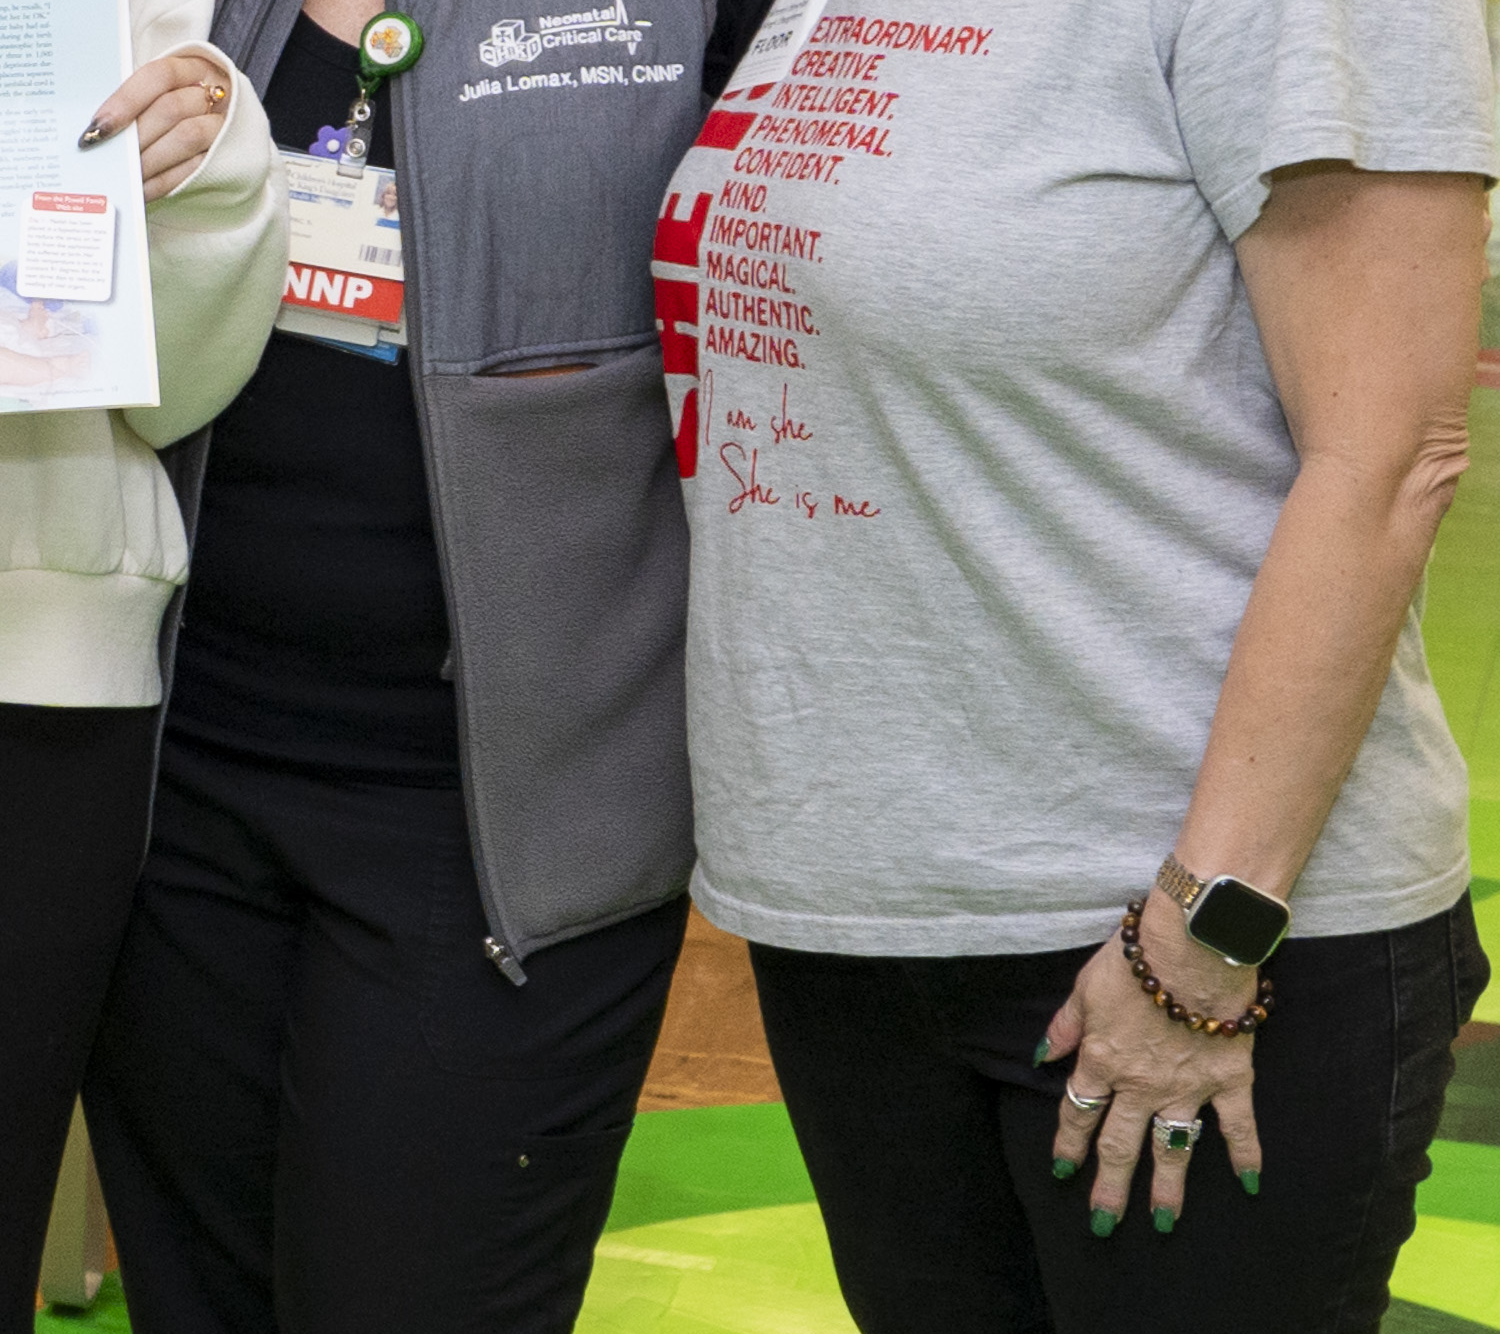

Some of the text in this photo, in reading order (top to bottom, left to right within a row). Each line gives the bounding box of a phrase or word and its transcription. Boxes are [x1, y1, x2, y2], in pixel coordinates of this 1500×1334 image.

[539, 5, 616, 29] Neonatal
[809, 16, 994, 56] EXTRAORDINARY.
[542, 27, 643, 48] Critical Care
[459, 63, 685, 102] Julia Lomax, MSN, CNNP
[790, 50, 886, 82] CREATIVE.
[771, 83, 900, 121] INTELLIGENT.
[751, 114, 894, 158] PHENOMENAL.
[733, 148, 844, 185] CONFIDENT.
[719, 179, 768, 214] KIND.
[708, 214, 823, 263] IMPORTANT.
[706, 251, 796, 295] MAGICAL.
[705, 287, 821, 336] AUTHENTIC.
[704, 325, 807, 370] AMAZING.
[727, 409, 758, 431] am
[770, 382, 814, 444] she
[719, 442, 882, 519] She is me
